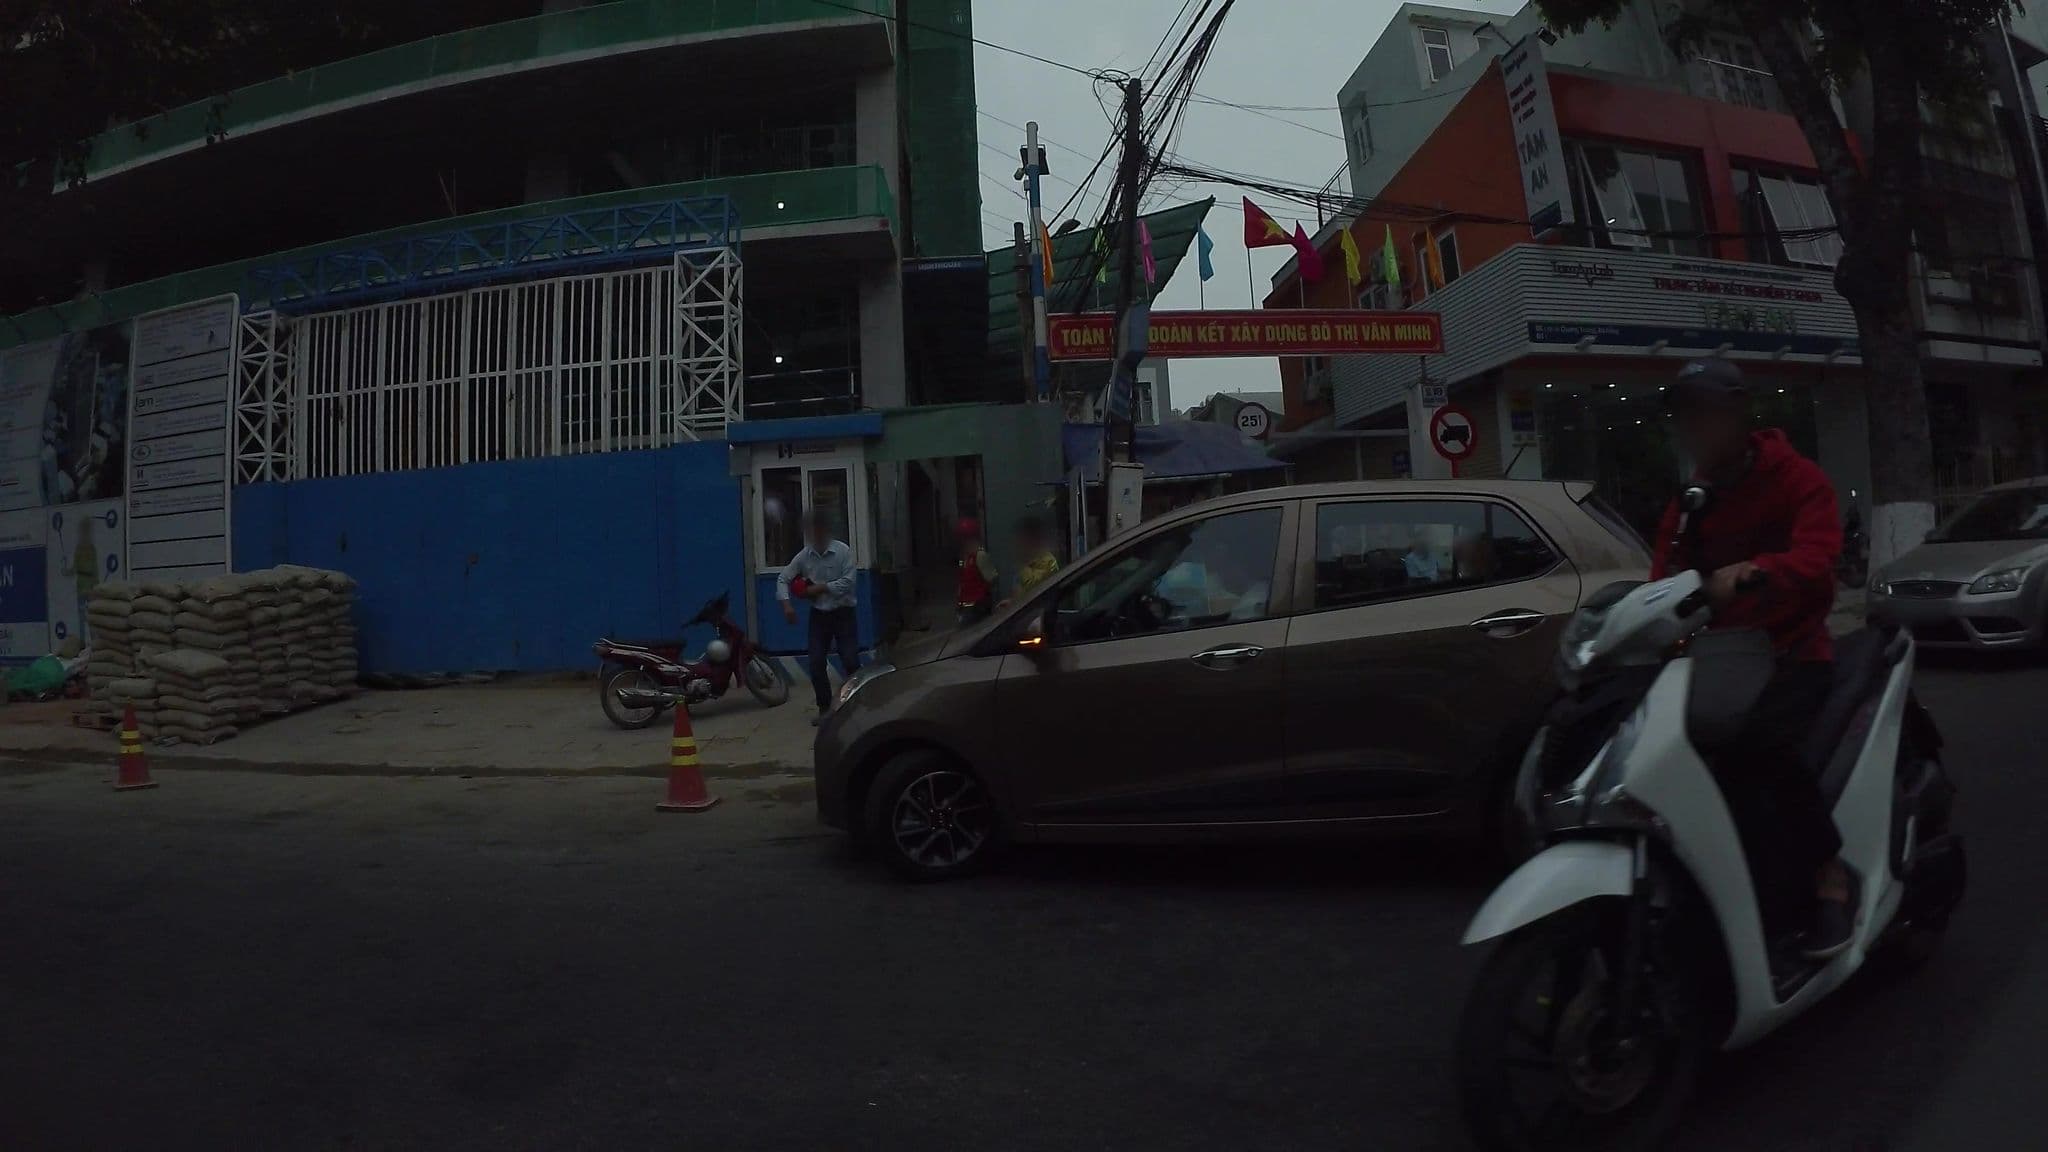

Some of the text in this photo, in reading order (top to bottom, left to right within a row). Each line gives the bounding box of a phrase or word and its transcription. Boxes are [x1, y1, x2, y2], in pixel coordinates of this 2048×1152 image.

[1061, 325, 1105, 346] TOÀN
[1197, 320, 1225, 342] KẾT
[1231, 321, 1260, 342] XÂY
[1265, 323, 1307, 345] DỰNG
[1311, 321, 1331, 342] ĐÔ
[1335, 323, 1358, 345] THỊ
[1394, 324, 1432, 342] MINH
